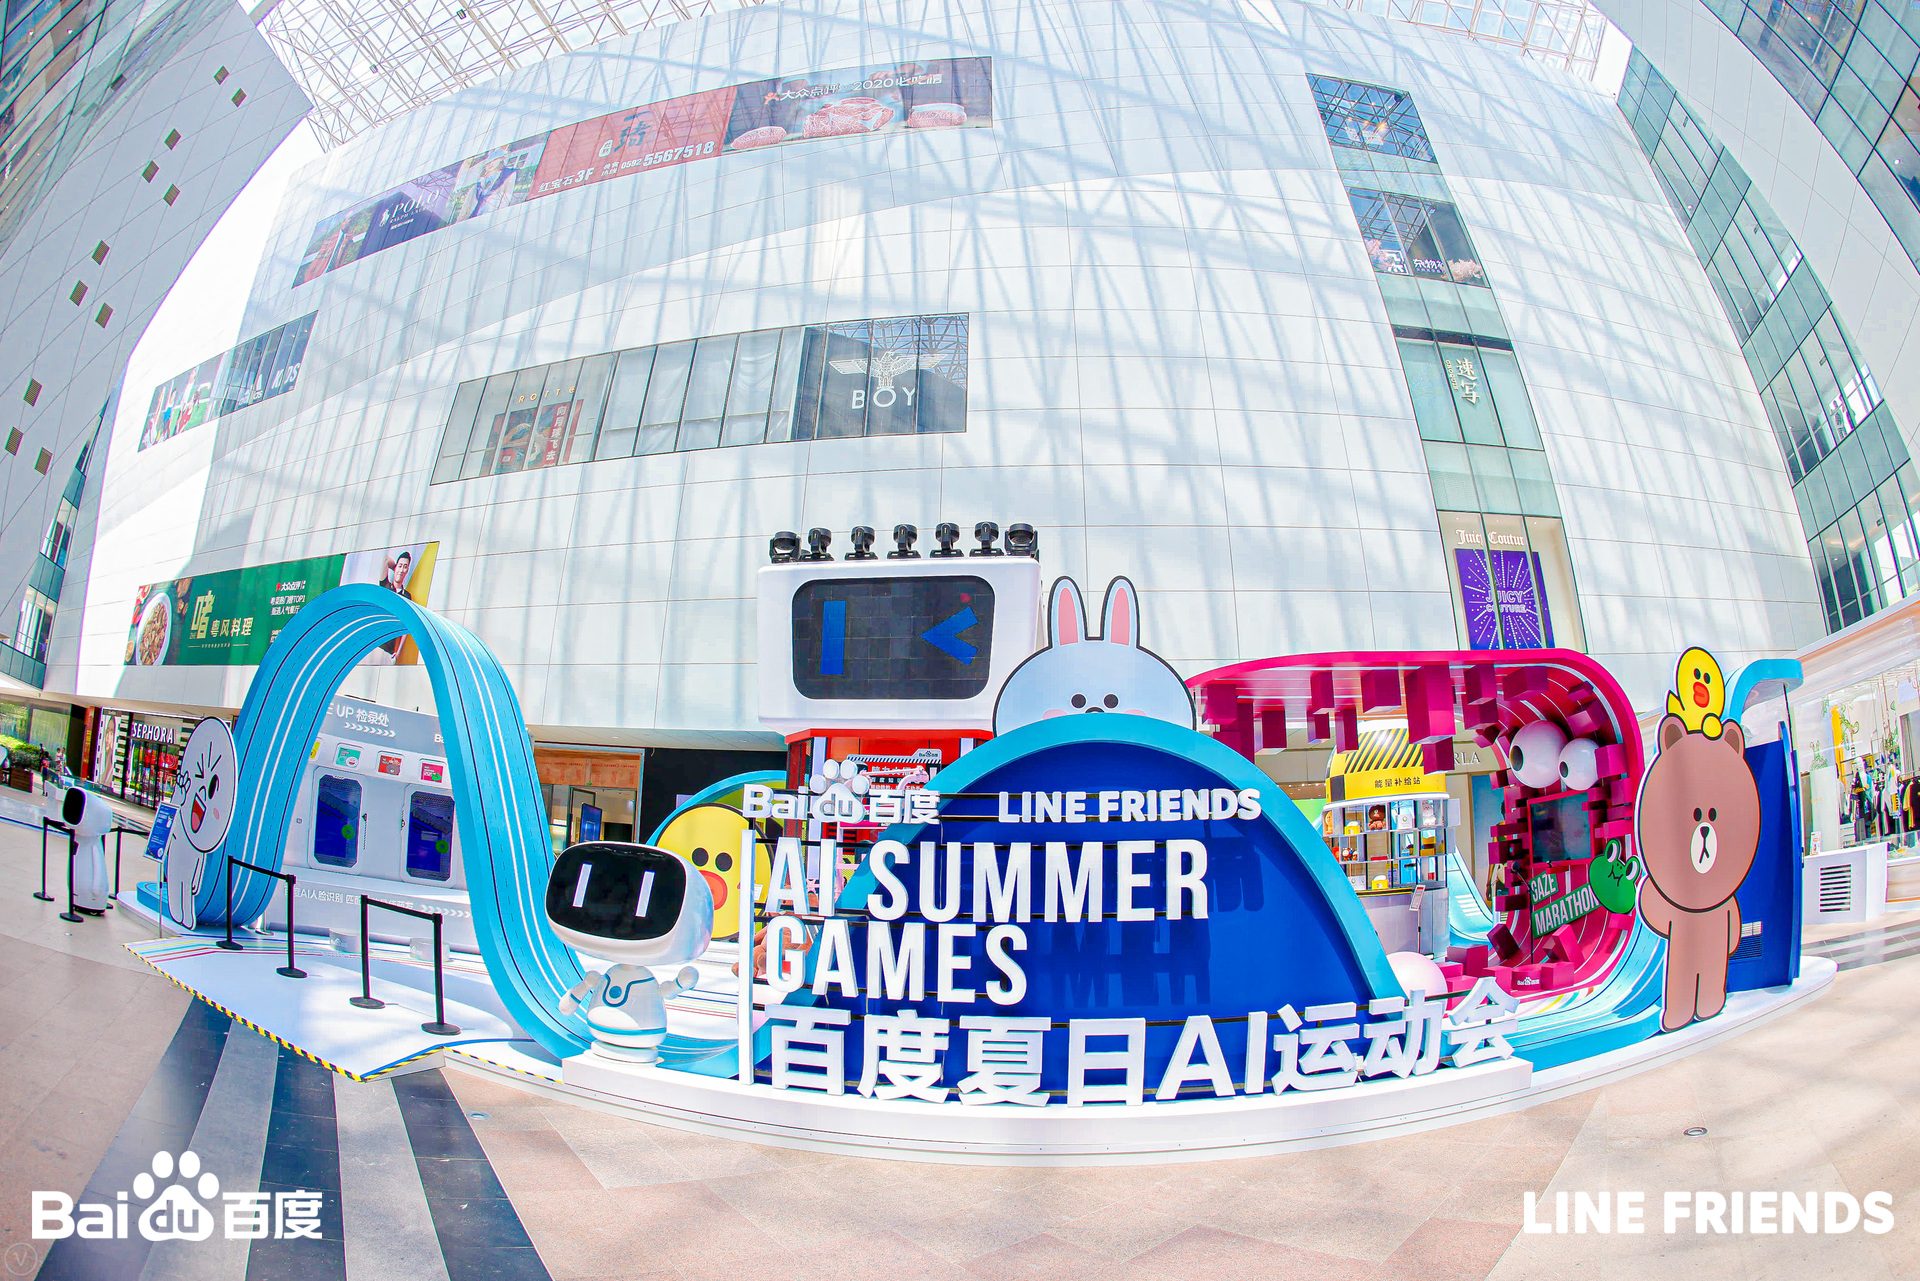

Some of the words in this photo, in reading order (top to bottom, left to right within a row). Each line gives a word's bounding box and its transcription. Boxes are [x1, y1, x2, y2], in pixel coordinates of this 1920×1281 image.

[621, 159, 642, 170] 0592
[643, 141, 715, 167] 5567518
[391, 189, 440, 219] POLO
[1455, 357, 1480, 405] 速写
[851, 386, 916, 409] BOY
[1487, 531, 1525, 546] Coutur
[210, 617, 254, 638] 粤风料理
[336, 704, 355, 719] UP
[356, 708, 390, 728] 检录处
[131, 722, 175, 744] SEPHORA
[1453, 751, 1481, 766] RLA
[998, 790, 1089, 823] LINE
[1098, 788, 1263, 822] FRIENDS
[765, 837, 836, 916] AI
[866, 838, 1209, 923] SUMMER
[1534, 884, 1600, 935] MARATHON
[765, 915, 1029, 1006] GAMES
